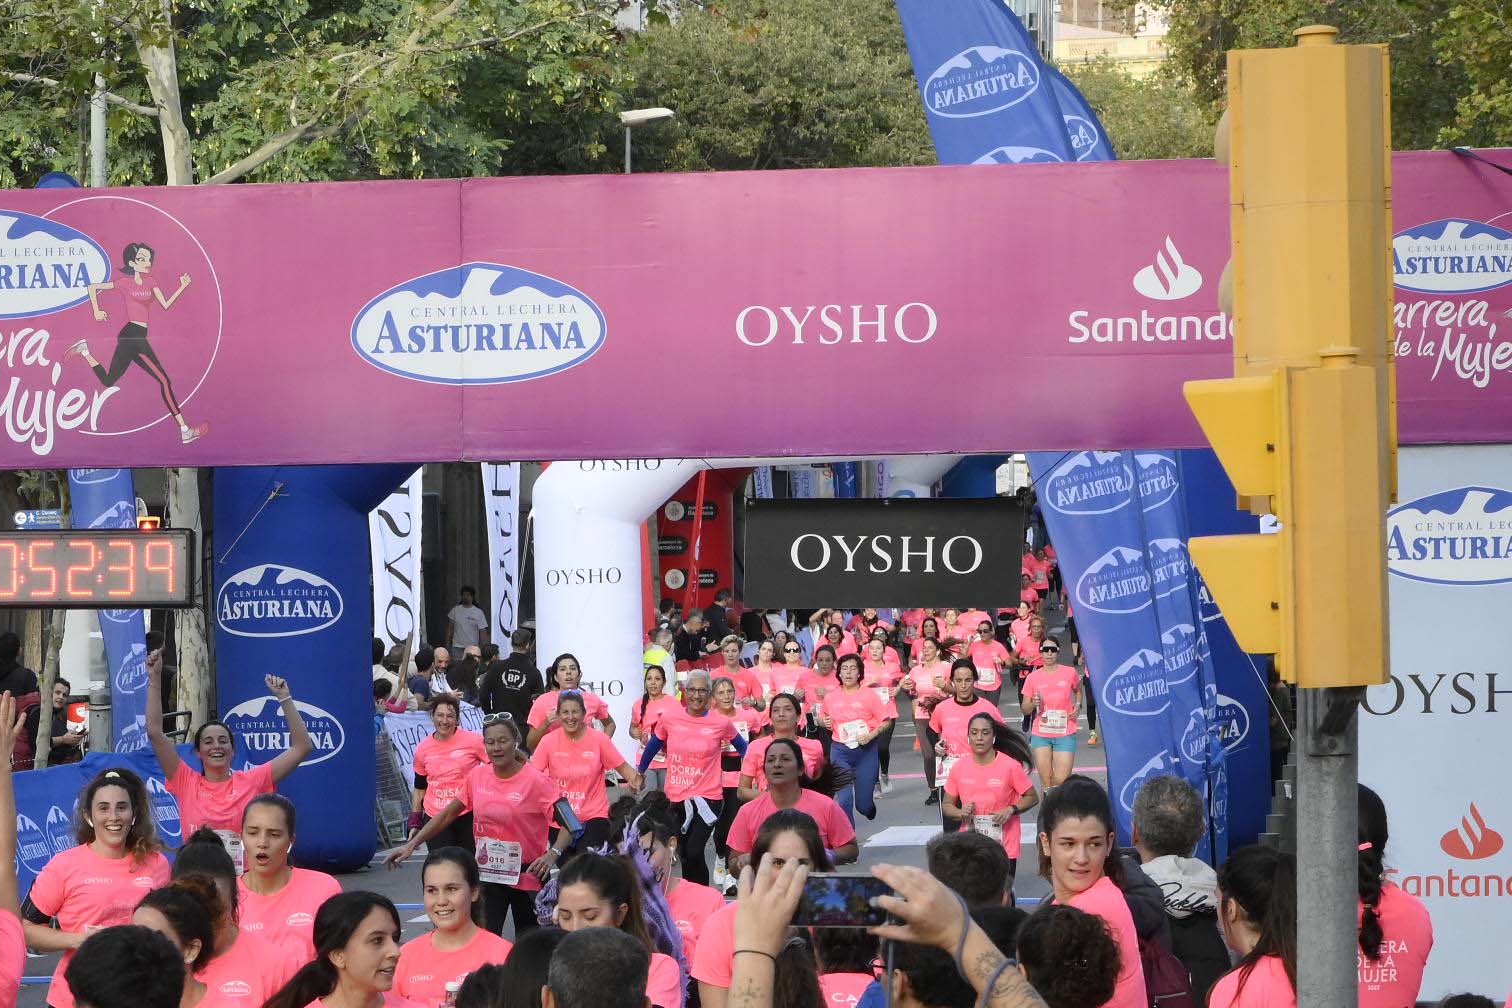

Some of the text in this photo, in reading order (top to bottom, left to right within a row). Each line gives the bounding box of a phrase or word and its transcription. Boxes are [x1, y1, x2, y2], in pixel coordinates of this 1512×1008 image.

[14, 247, 86, 258] LECHERA
[1408, 244, 1512, 253] CENTRAL LECHER
[411, 302, 577, 317] CENTRAL LECHERA
[1394, 300, 1489, 328] arrera
[371, 310, 586, 354] ASTURIANA
[735, 302, 937, 346] OYSHO
[1068, 308, 1234, 344] Santand
[1418, 329, 1435, 356] la
[1431, 323, 1512, 388] Muje
[1415, 520, 1482, 531] CENTRAL
[790, 533, 983, 575] OYSHO
[546, 566, 622, 586] OYSHO
[234, 588, 329, 598] CENTRAL LECHERA
[221, 594, 334, 620] ASTURIANA
[507, 673, 520, 684] BP
[1360, 672, 1512, 716] OYSH
[243, 732, 335, 750] TURINA
[1385, 868, 1512, 897] Santan
